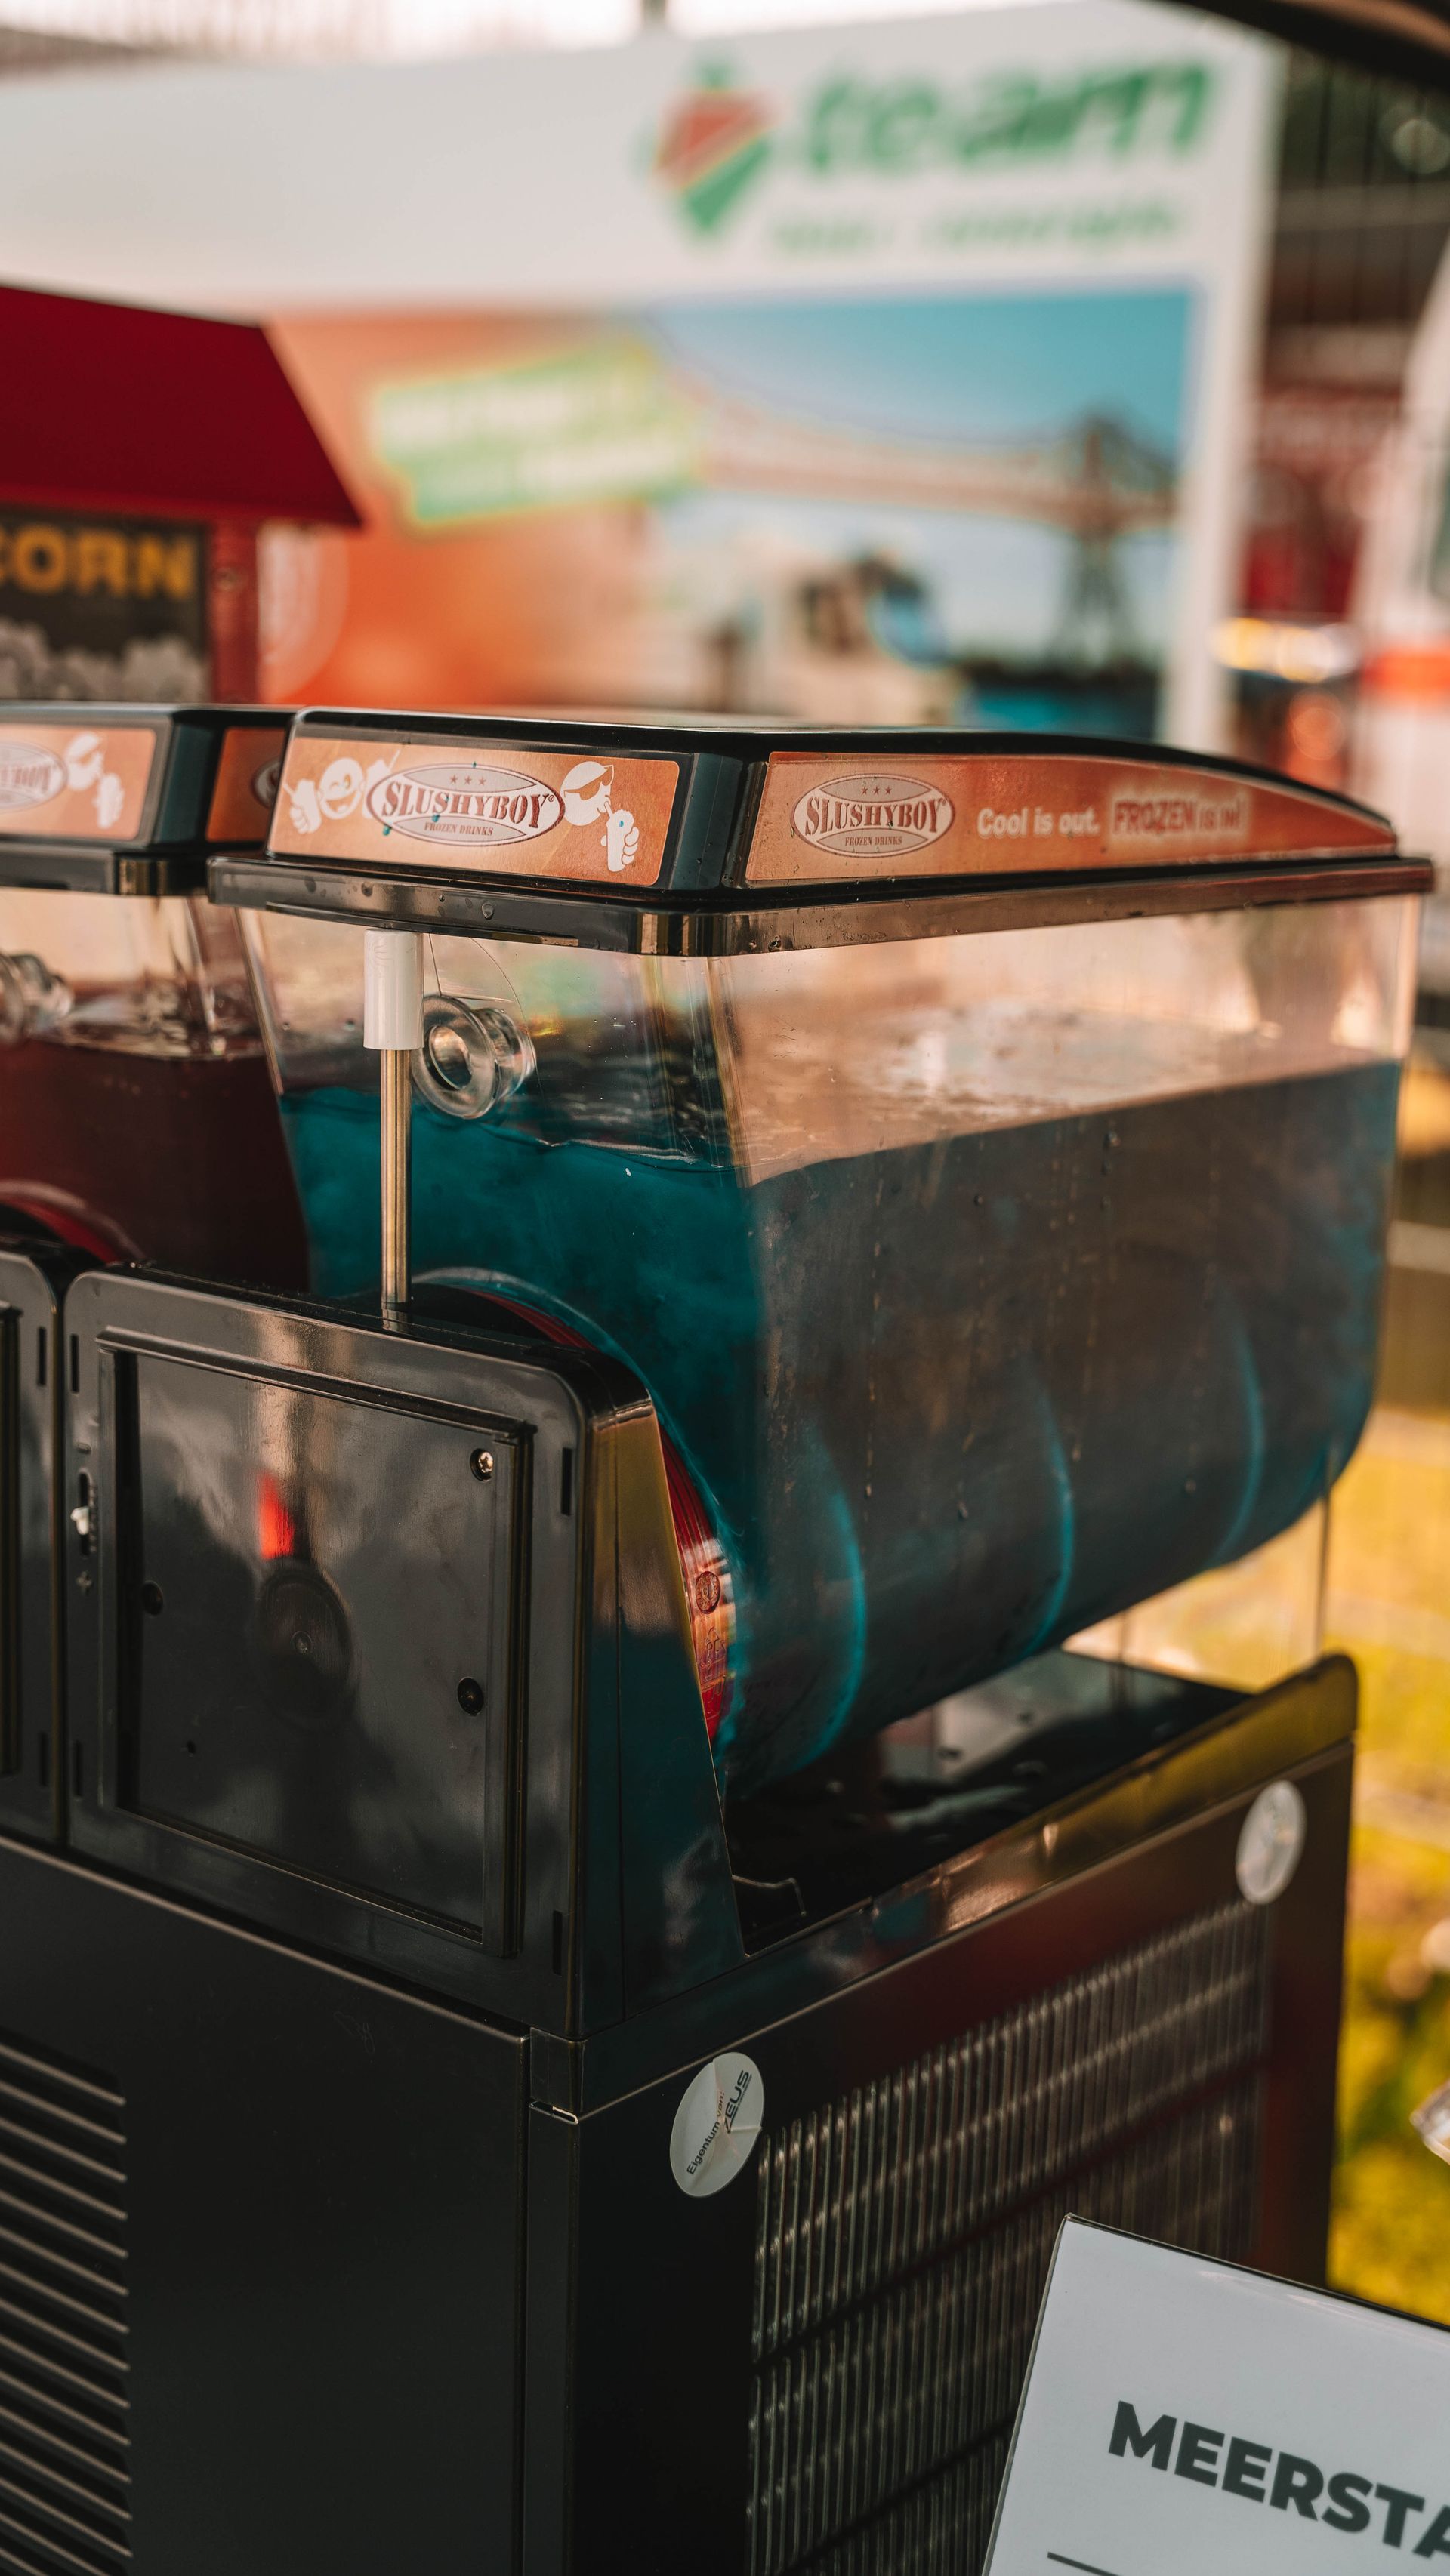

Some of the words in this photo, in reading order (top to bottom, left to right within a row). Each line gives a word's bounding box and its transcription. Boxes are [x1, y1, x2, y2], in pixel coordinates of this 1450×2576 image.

[424, 821, 459, 834] FROZEN
[459, 822, 493, 836] DRINKS
[977, 807, 1028, 838] Cool
[1033, 807, 1053, 836] is
[1058, 807, 1102, 836] out.
[1114, 799, 1194, 832] FROZEN
[844, 836, 872, 846] FROZEN
[875, 836, 902, 846] DRINKS
[723, 2070, 752, 2134] ZEUS
[686, 2121, 720, 2175] Eigentum
[717, 2091, 726, 2118] von:
